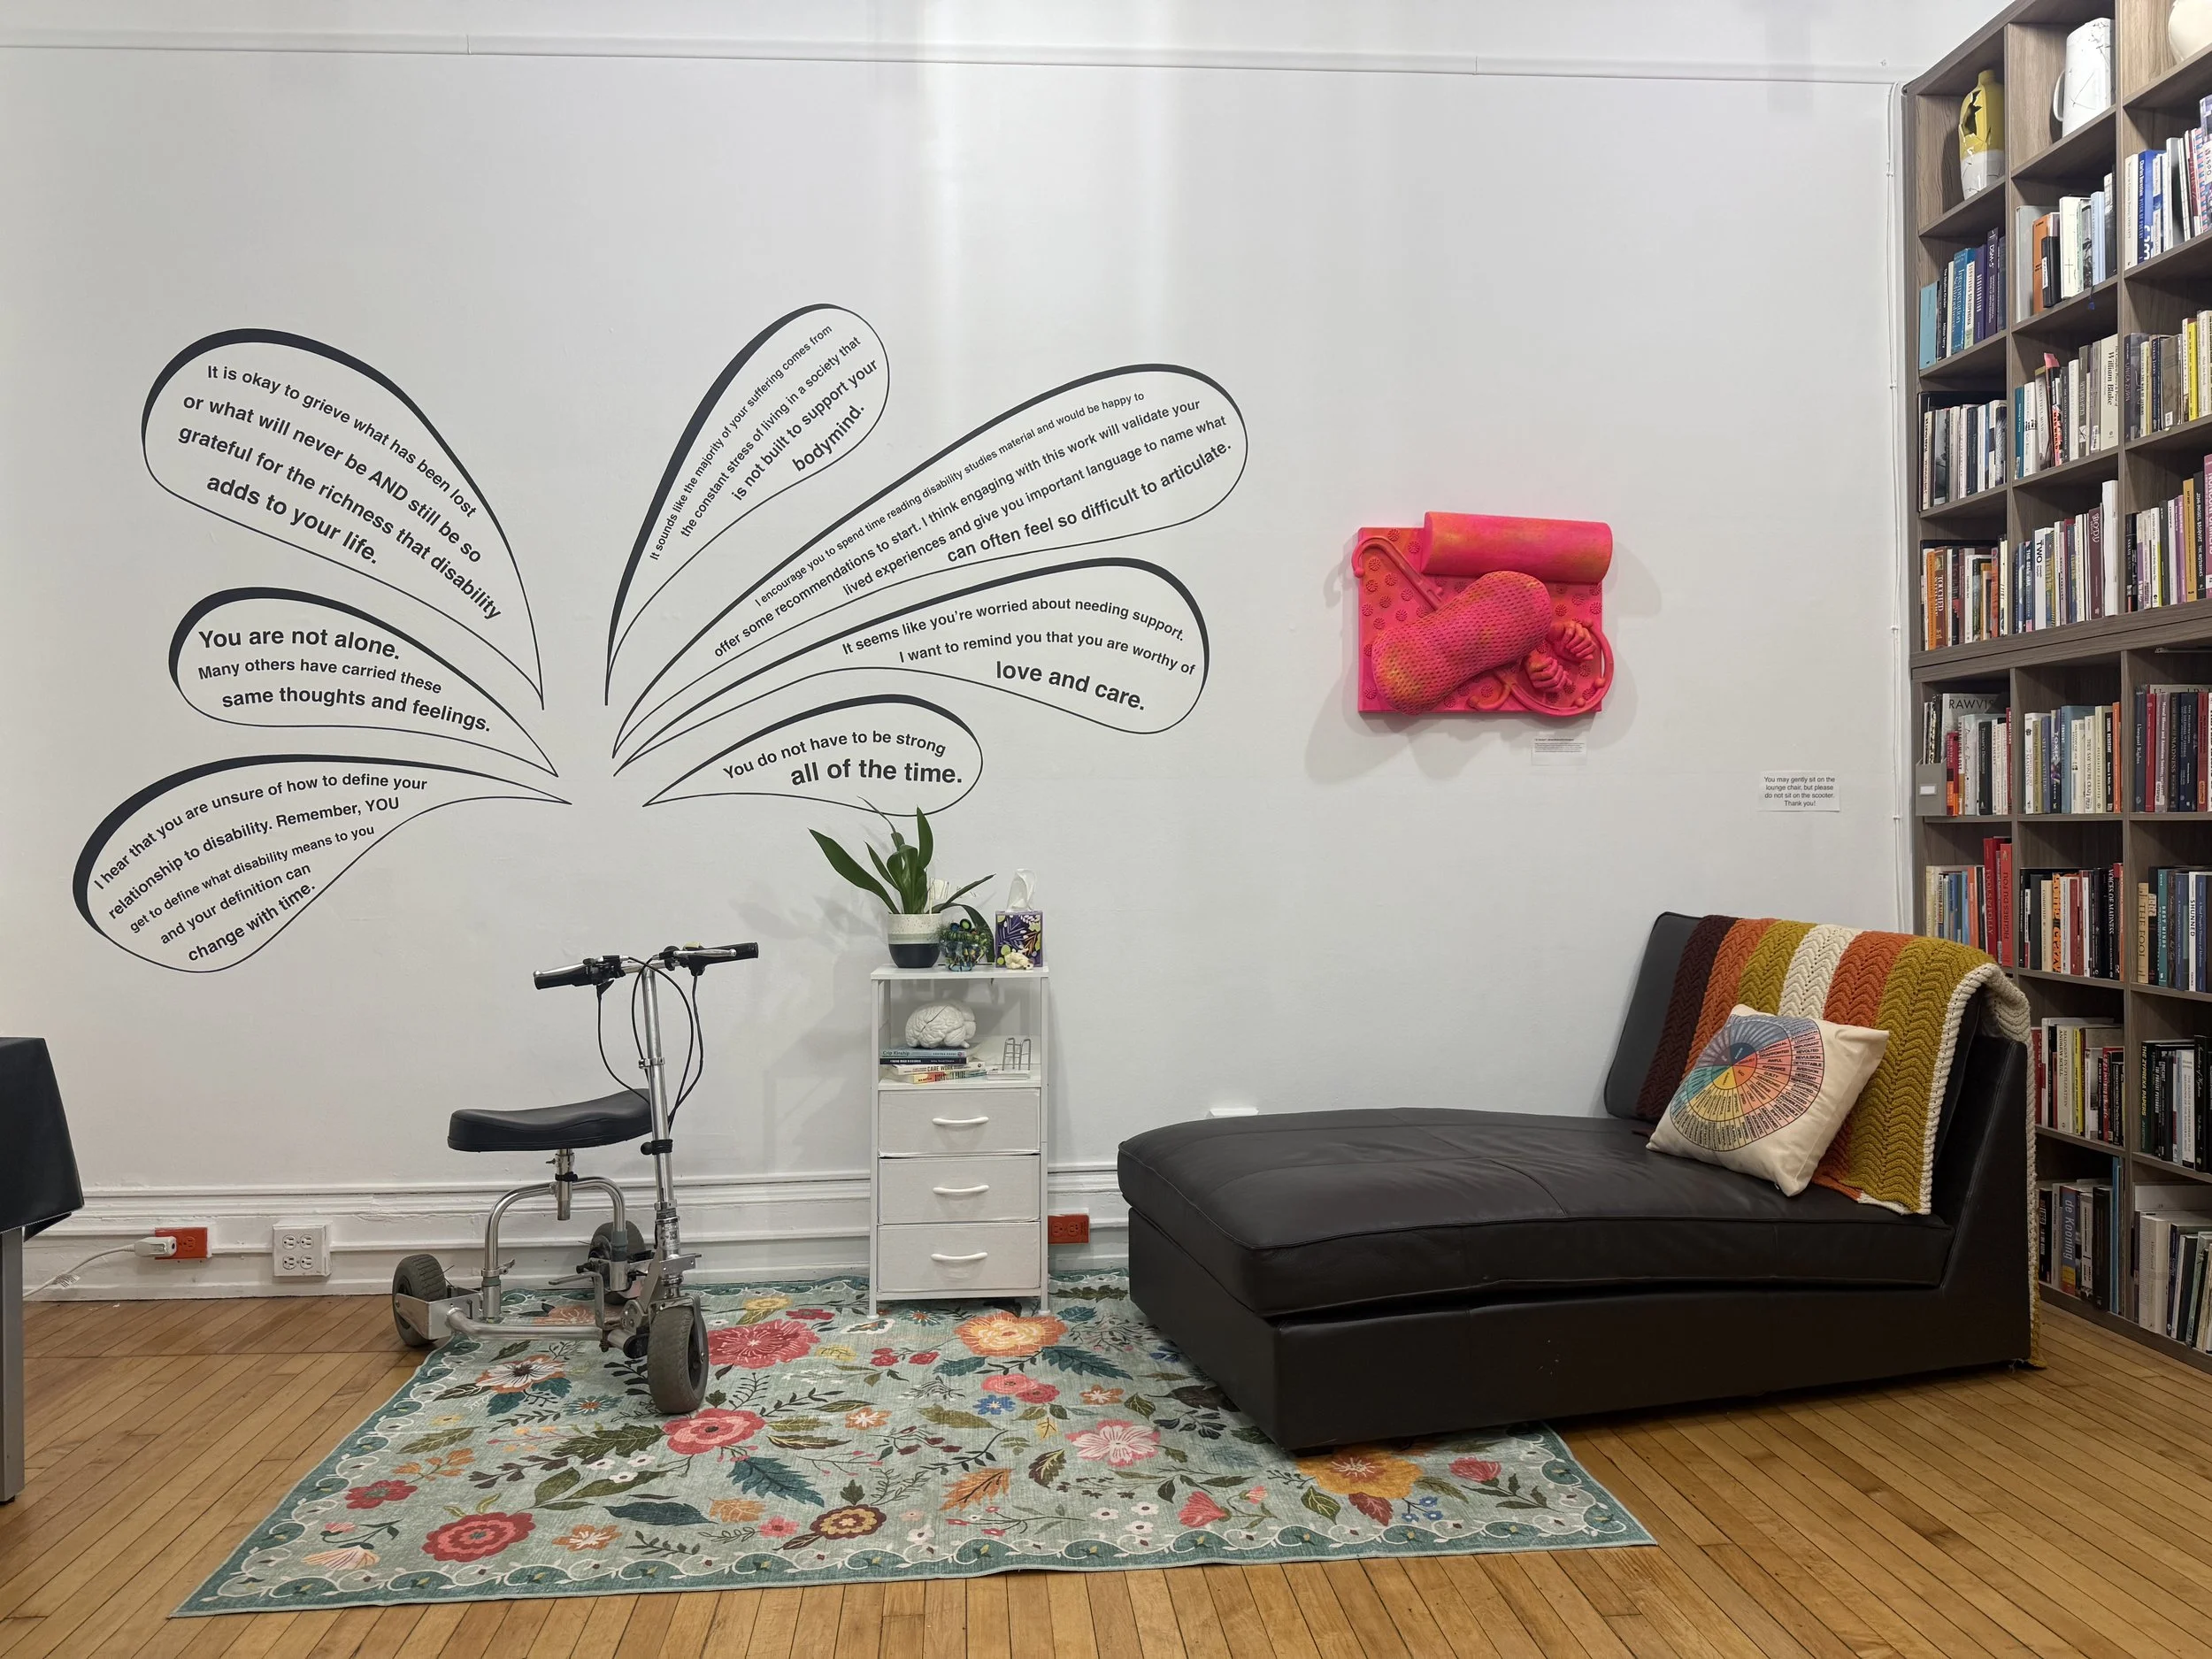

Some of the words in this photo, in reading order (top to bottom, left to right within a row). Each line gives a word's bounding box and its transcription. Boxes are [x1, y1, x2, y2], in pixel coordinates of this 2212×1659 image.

[1955, 268, 1965, 323] Interpretation
[208, 365, 218, 378] It
[224, 366, 236, 380] is
[242, 373, 280, 394] okay
[284, 385, 299, 399] to
[302, 396, 349, 423] grieve
[354, 419, 389, 445] what
[389, 439, 416, 464] has
[417, 459, 449, 492] been
[449, 488, 476, 518] lost
[656, 514, 677, 551] sounds
[672, 495, 687, 512] like
[684, 478, 697, 493] the
[695, 439, 724, 476] majority
[722, 426, 731, 438] of
[730, 406, 748, 429] your
[748, 370, 784, 406] suffering
[783, 344, 810, 370] comes
[810, 326, 832, 345] from
[792, 405, 864, 472] bodymind.
[207, 478, 260, 504] adds
[266, 495, 287, 515] to
[290, 508, 341, 539] your
[342, 531, 376, 564] life.
[762, 567, 807, 603] encourage
[807, 555, 825, 571] you
[825, 548, 835, 557] to
[837, 527, 864, 549] spend
[865, 517, 886, 532] time
[887, 495, 922, 518] reading
[923, 471, 963, 497] disability
[964, 451, 997, 473] studies
[999, 429, 1035, 454] material
[1037, 420, 1055, 434] and
[1056, 408, 1085, 425] would
[1102, 396, 1131, 409] happy
[948, 544, 976, 562] can
[980, 530, 1021, 549] often
[1024, 518, 1054, 537] feel
[1058, 514, 1077, 527] so
[1081, 488, 1140, 519] difficult
[1141, 482, 1156, 495] to
[1161, 444, 1231, 487] articulate.
[198, 630, 241, 648] You
[250, 631, 284, 645] are
[292, 629, 327, 646] not
[334, 632, 399, 659] alone.
[842, 643, 853, 655] It
[856, 629, 899, 649] seems
[902, 622, 926, 634] like
[930, 611, 972, 630] you're
[976, 599, 1027, 617] worried
[1033, 598, 1071, 610] about
[1075, 602, 1129, 619] needing
[1133, 611, 1182, 641] support.
[997, 661, 1042, 681] love
[1048, 672, 1090, 692] and
[1095, 684, 1144, 710] care.
[791, 762, 818, 785] all
[827, 758, 850, 779] of
[858, 759, 896, 780] the
[904, 763, 962, 783] time.
[94, 880, 104, 889] I
[100, 856, 129, 883] hear
[129, 833, 157, 856] that
[156, 816, 183, 839] you
[186, 804, 208, 819] are
[211, 789, 264, 808] unsure
[268, 782, 282, 795] of
[287, 779, 318, 792] how
[322, 776, 337, 787] to
[342, 773, 388, 787] define
[394, 779, 427, 790] your
[188, 927, 244, 961] change
[246, 908, 279, 930] with
[278, 885, 315, 910] time.
[2063, 1217, 2074, 1260] Kooning
[2064, 1199, 2074, 1212] de
